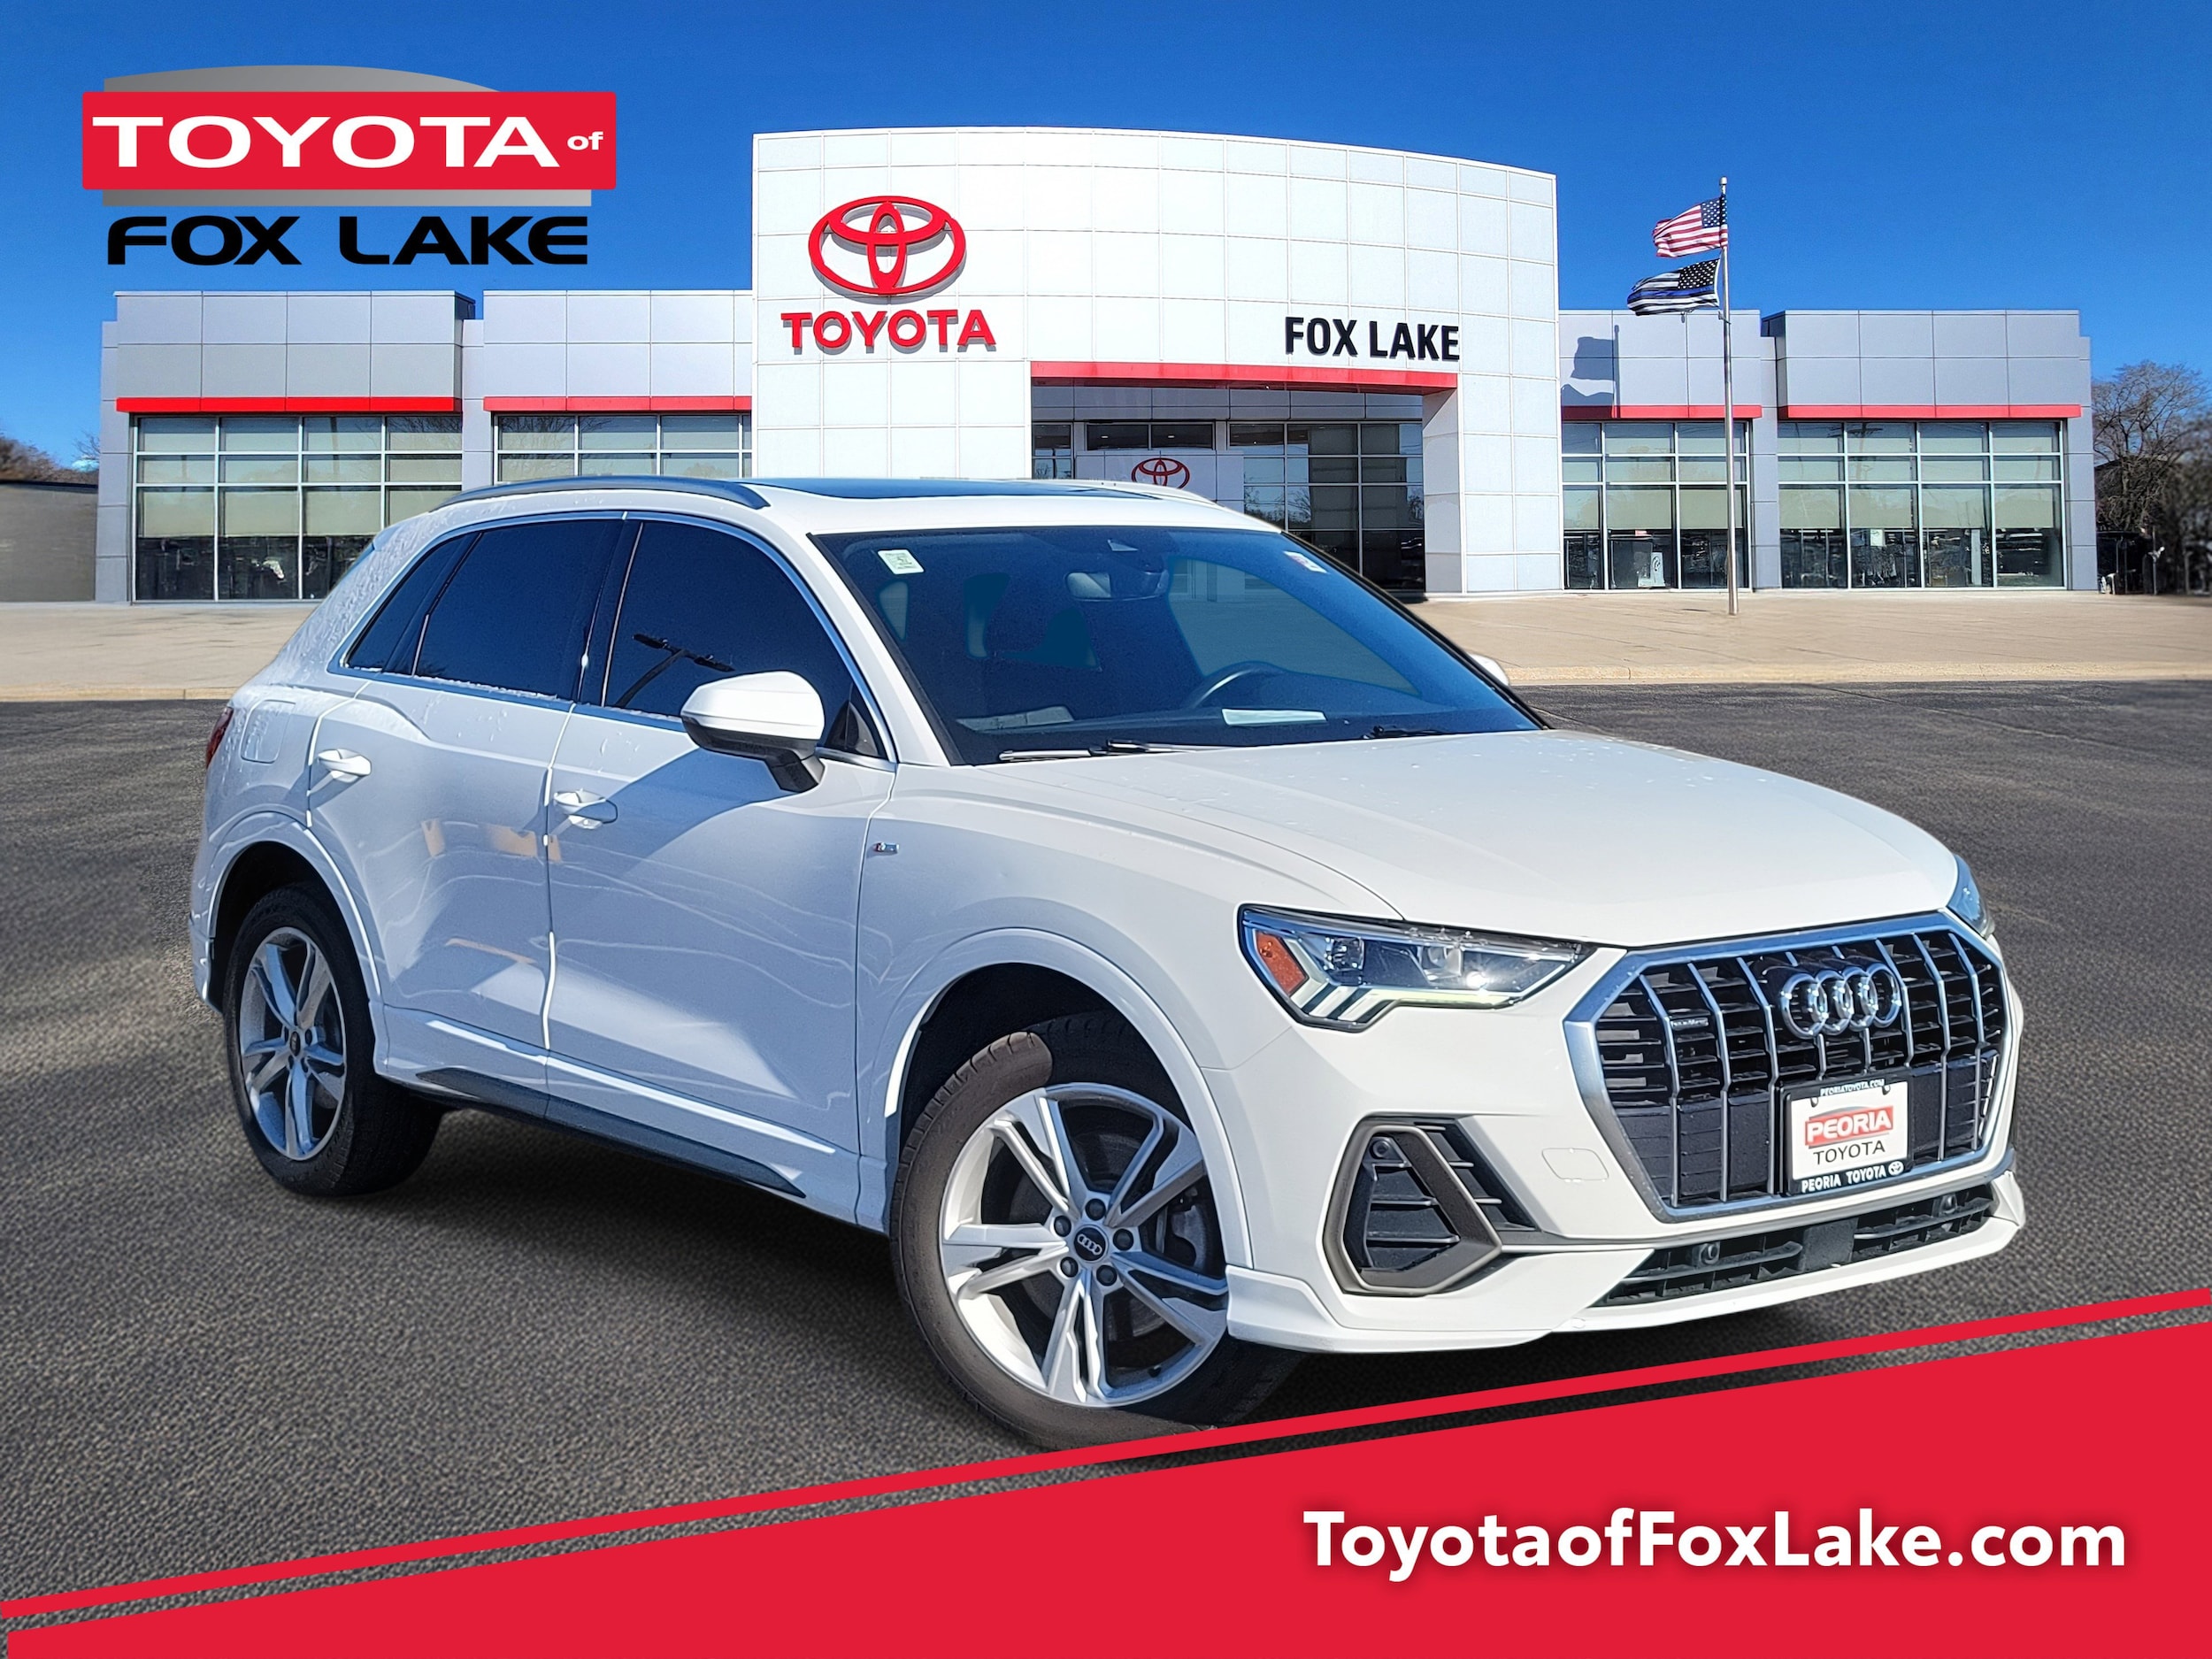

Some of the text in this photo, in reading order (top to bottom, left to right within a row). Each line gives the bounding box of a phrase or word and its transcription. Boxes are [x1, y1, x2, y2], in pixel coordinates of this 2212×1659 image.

[780, 309, 996, 352] TOYOTA
[1285, 315, 1461, 362] FOX LAKE
[1806, 1110, 1893, 1143] PEORIA
[1813, 1140, 1886, 1165] TOYOTA
[1801, 1164, 1886, 1193] PEORIA TOYOTA
